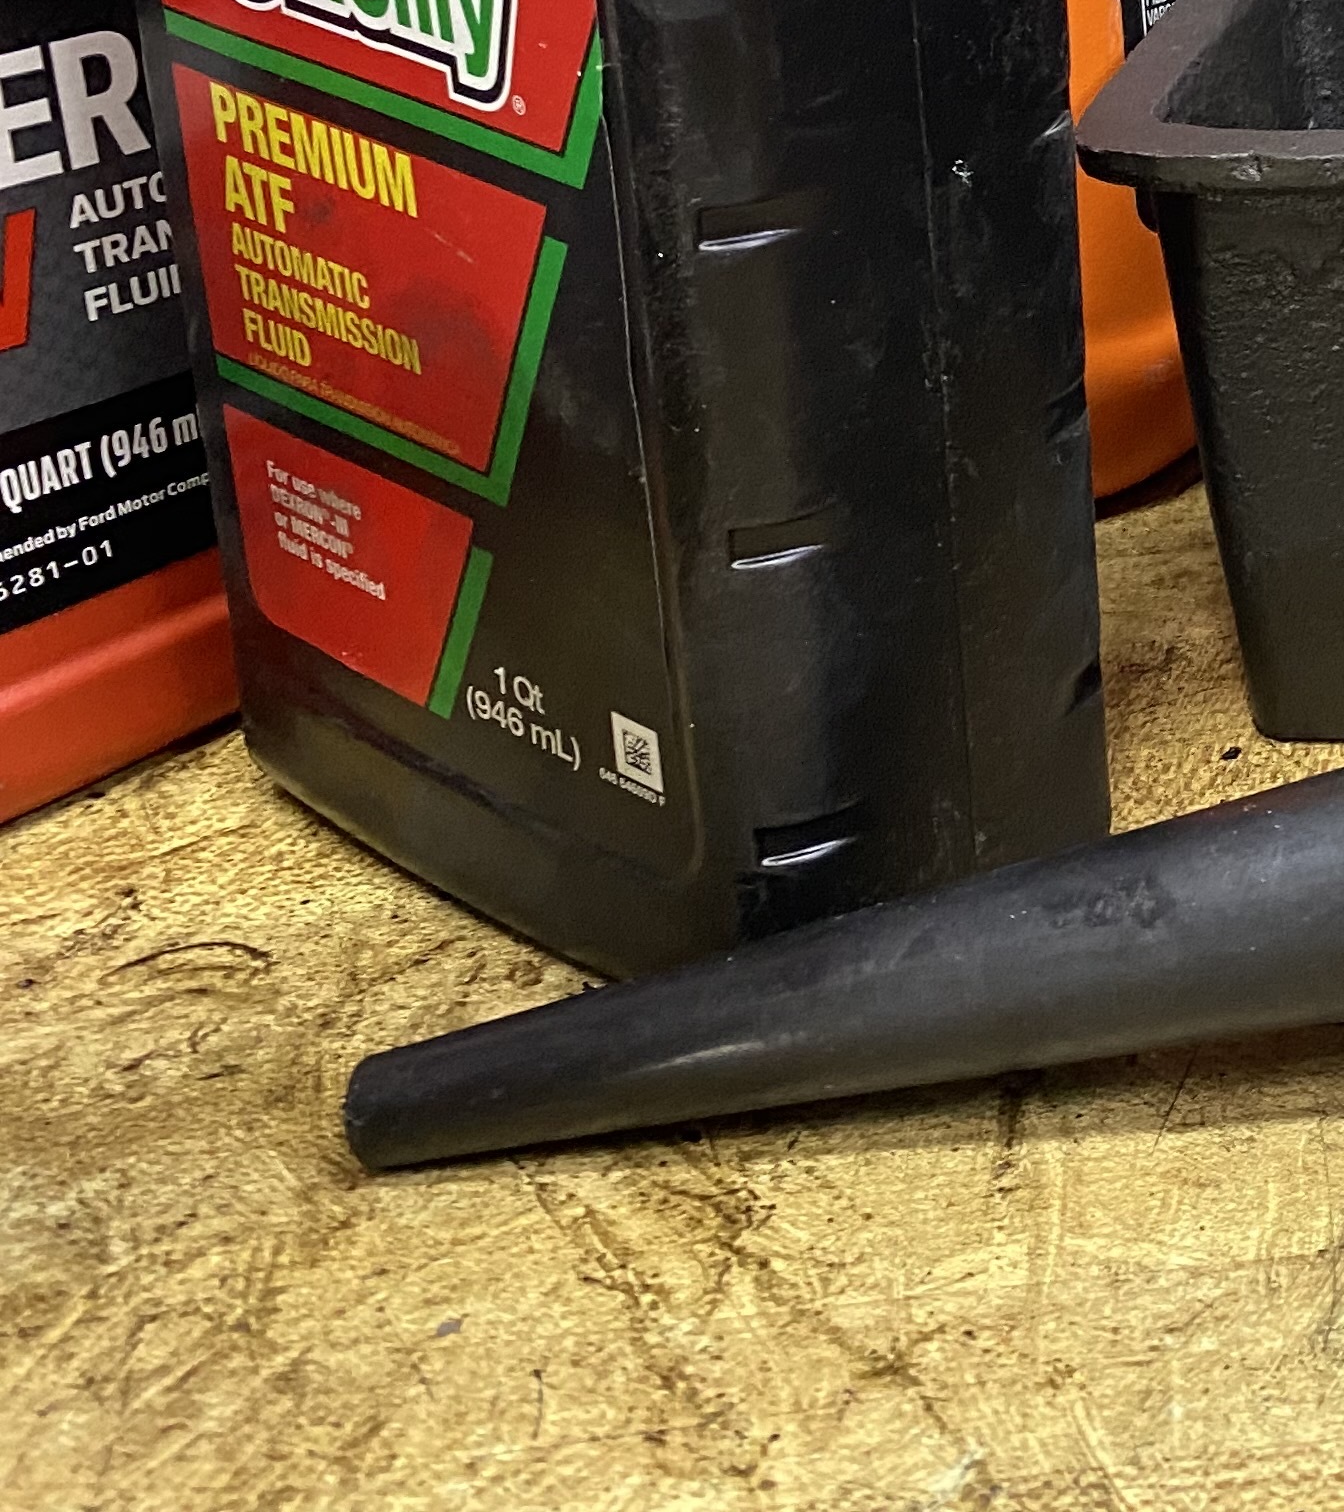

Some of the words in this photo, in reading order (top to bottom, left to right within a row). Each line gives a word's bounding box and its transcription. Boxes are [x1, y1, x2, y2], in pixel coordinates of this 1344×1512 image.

[209, 80, 419, 219] PREMIUM
[224, 154, 296, 234] ATF
[231, 221, 371, 310] AUTOMATIC
[234, 263, 423, 376] TRANSMISSION
[242, 307, 313, 368] FLUID
[0, 441, 94, 514] QUART
[101, 412, 168, 478] (946
[266, 458, 290, 486] For
[0, 528, 55, 563] ended
[55, 521, 77, 546] by
[78, 504, 118, 532] Ford
[117, 486, 166, 517] Motor
[324, 557, 387, 602] specified
[465, 685, 526, 738] (946
[529, 722, 582, 772] mL)
[493, 665, 507, 695] 1
[512, 675, 546, 715] Qt
